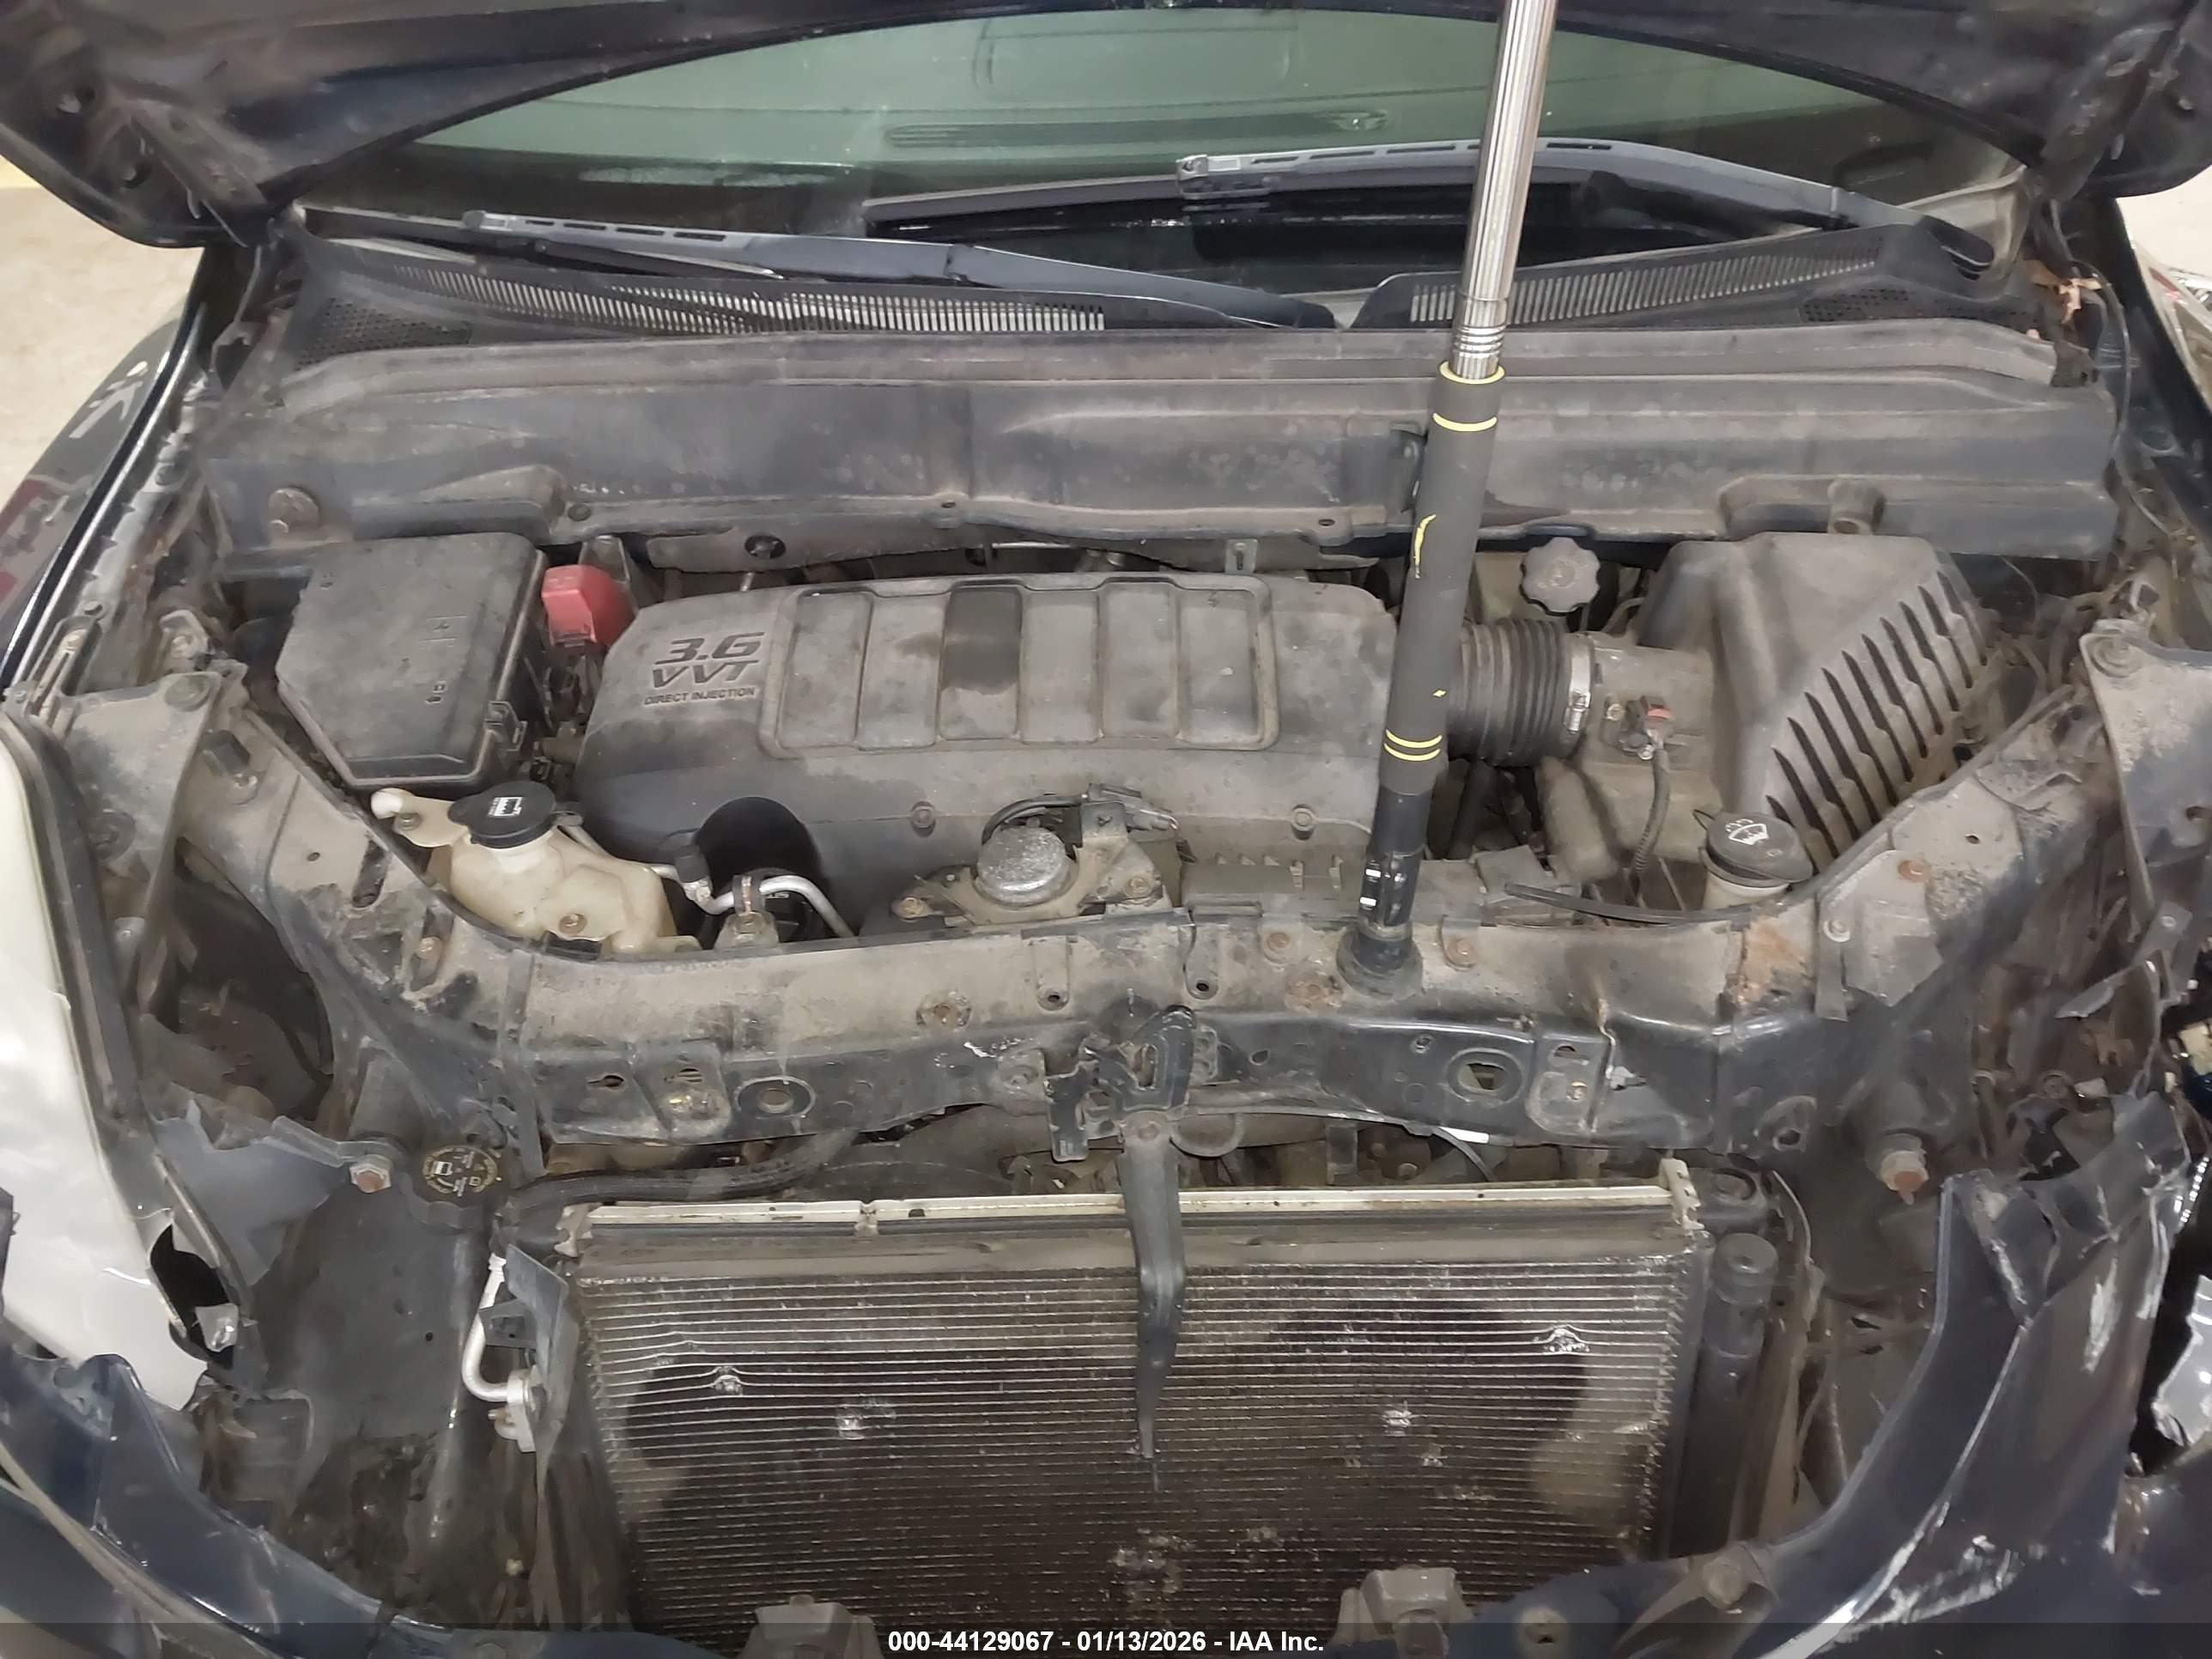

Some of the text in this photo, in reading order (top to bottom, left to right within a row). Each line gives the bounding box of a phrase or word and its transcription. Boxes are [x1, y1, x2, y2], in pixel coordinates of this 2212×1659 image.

[655, 632, 765, 665] 3.6
[653, 659, 758, 688] VVT
[645, 688, 755, 704] DIRECT INJECTION
